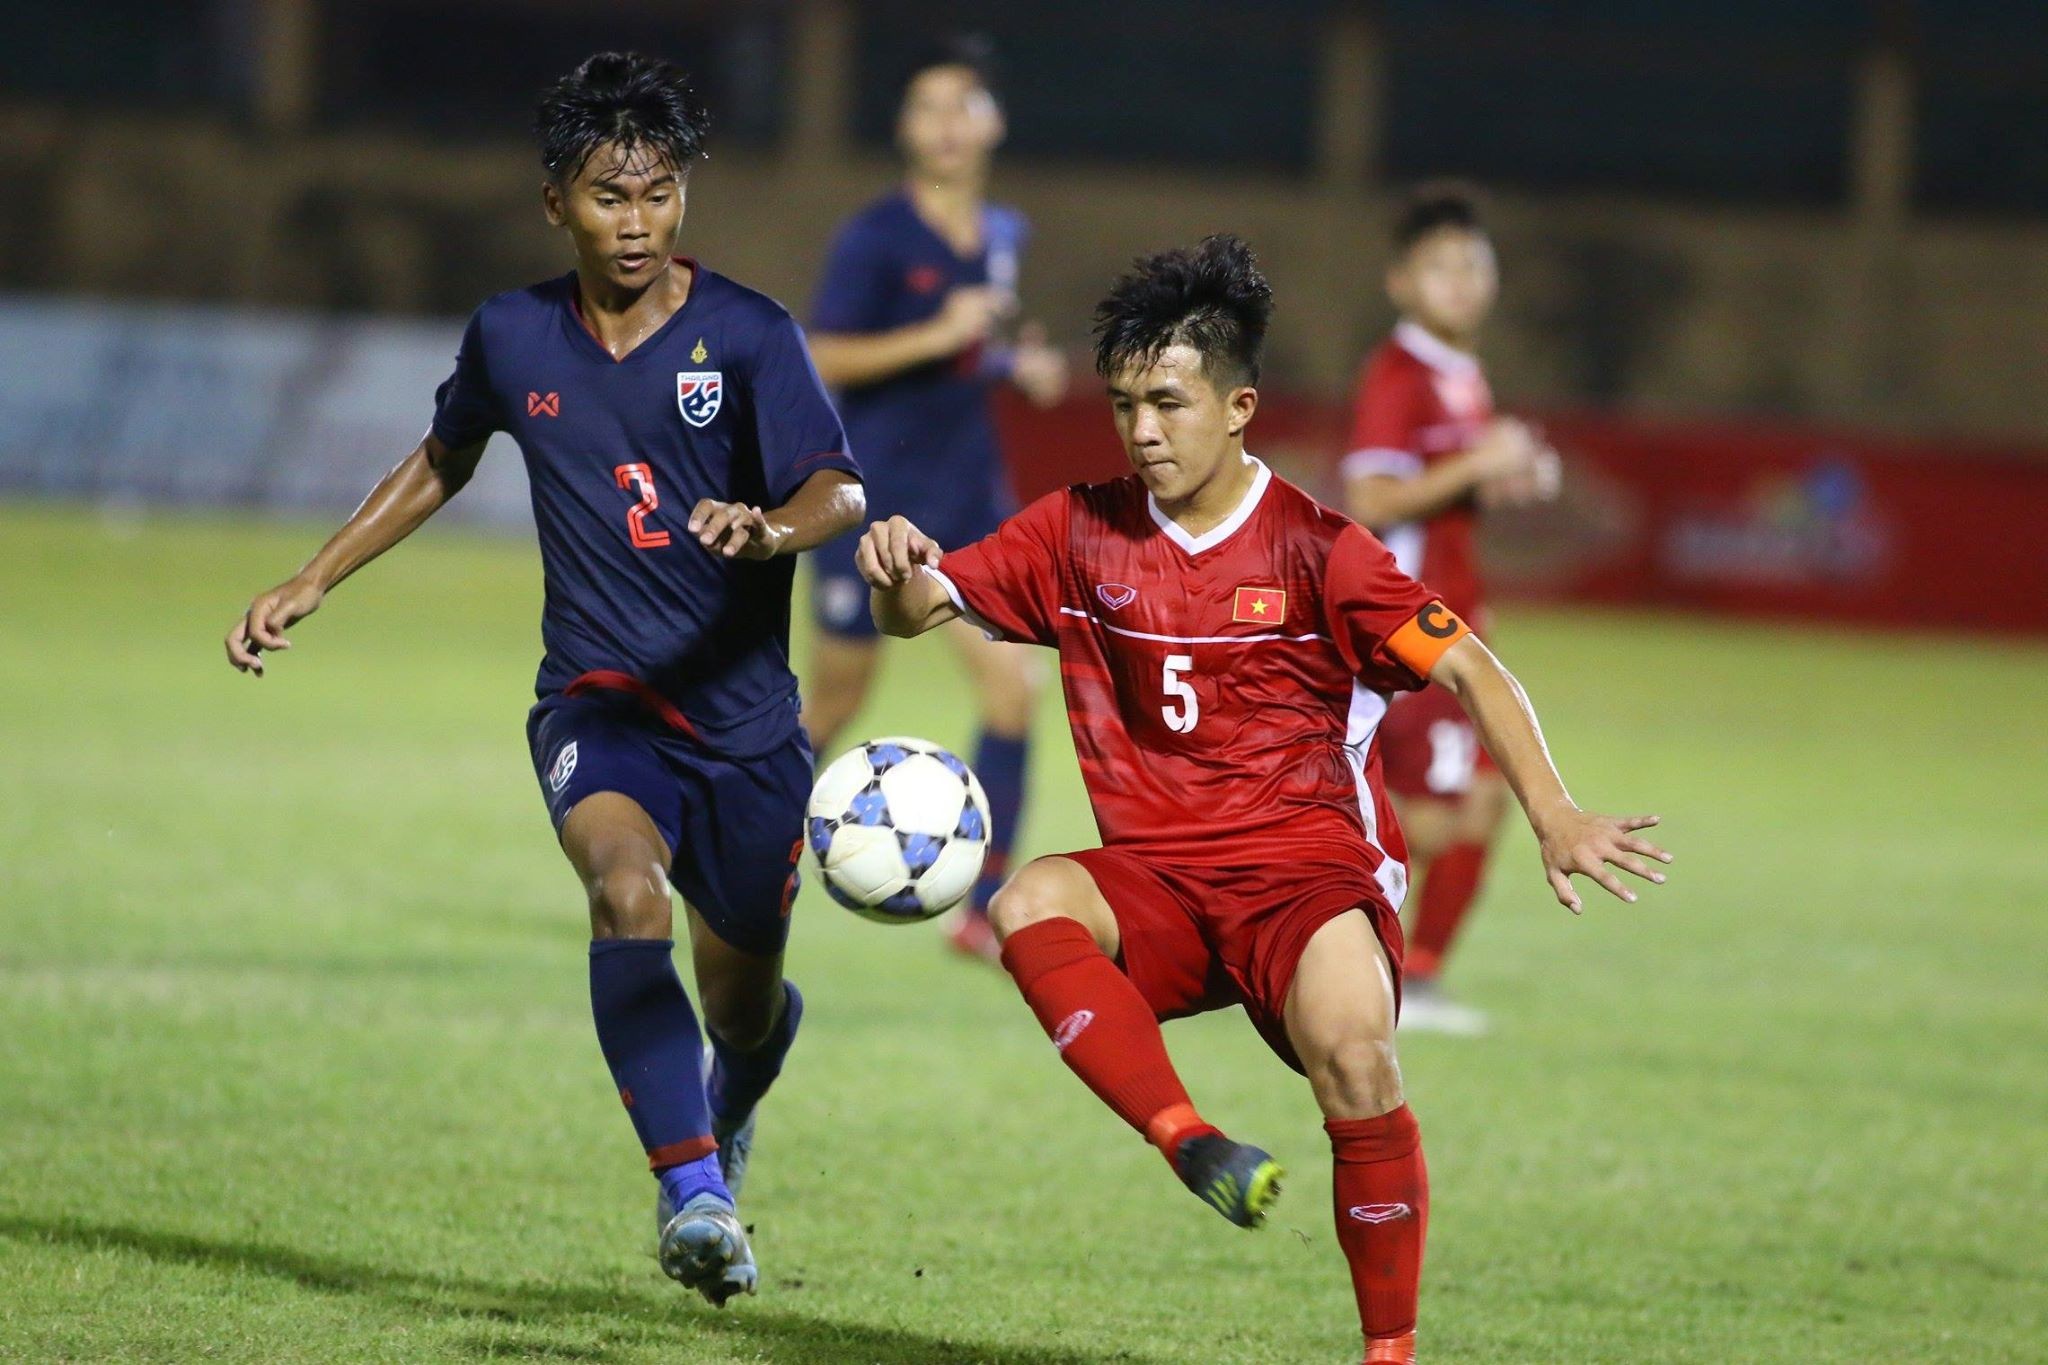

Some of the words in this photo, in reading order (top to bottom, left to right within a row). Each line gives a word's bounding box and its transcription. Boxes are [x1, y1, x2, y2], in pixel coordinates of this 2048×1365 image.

[680, 374, 719, 382] THAILAND
[614, 461, 672, 549] 2
[1417, 604, 1458, 638] C
[1161, 654, 1199, 734] 5
